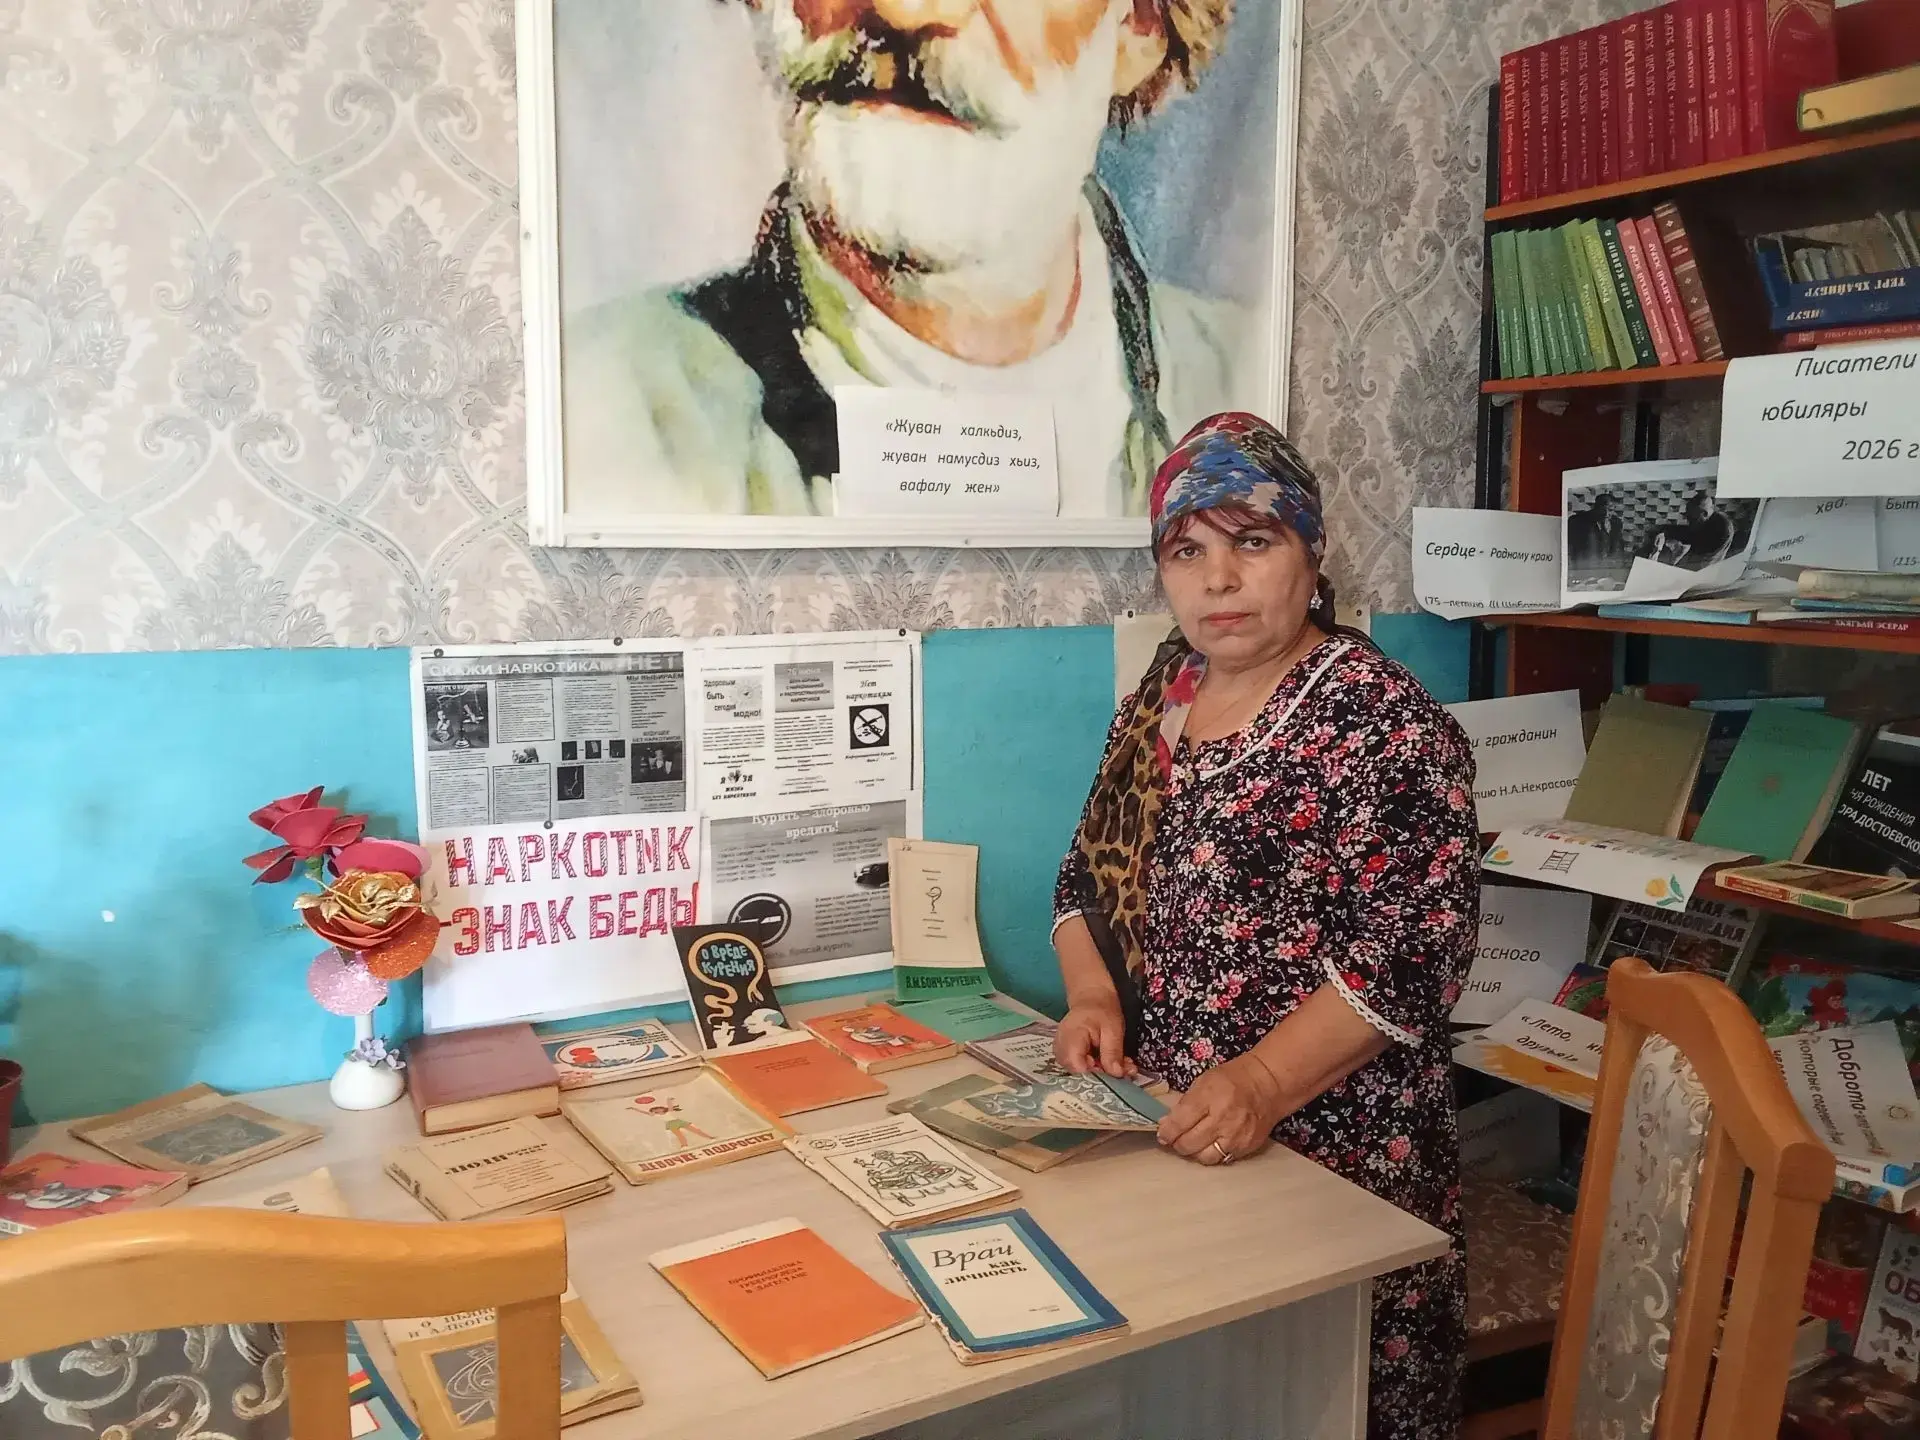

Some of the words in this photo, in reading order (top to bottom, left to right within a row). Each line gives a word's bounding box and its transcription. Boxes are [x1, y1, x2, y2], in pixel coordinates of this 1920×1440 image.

[1794, 352, 1916, 379] Писатели
[1761, 398, 1868, 423] юбиляры
[886, 418, 941, 436] «Жуван
[960, 425, 1022, 441] халкьдиз,
[881, 450, 927, 464] жуван
[937, 453, 1000, 467] намусдиз
[1009, 456, 1041, 469] хьиз,
[1842, 439, 1901, 461] 2026
[900, 478, 951, 495] вафалу
[964, 481, 1000, 494] жен»
[1426, 542, 1476, 560] Сердце
[1490, 547, 1530, 563] Родному
[1530, 552, 1553, 562] краю
[706, 691, 725, 700] быть
[733, 708, 762, 718] модно!
[1485, 728, 1557, 748] гражданин
[1861, 769, 1892, 792] ЛЕТ
[1471, 789, 1497, 799] тию
[1863, 795, 1916, 828] РОЖДЕНИЯ
[1855, 814, 1920, 855] ДОСТОЕВСКО
[445, 826, 693, 888] НАРКОТИК
[589, 882, 699, 939] БЕДЫ
[701, 949, 709, 960] О
[711, 944, 748, 961] ВРЕДЕ
[701, 959, 756, 978] КУРЕНИЯ
[931, 1244, 1014, 1271] Врач
[989, 1258, 1021, 1269] как
[944, 1267, 1028, 1285] личность
[430, 1314, 495, 1335] АЛКОГО
